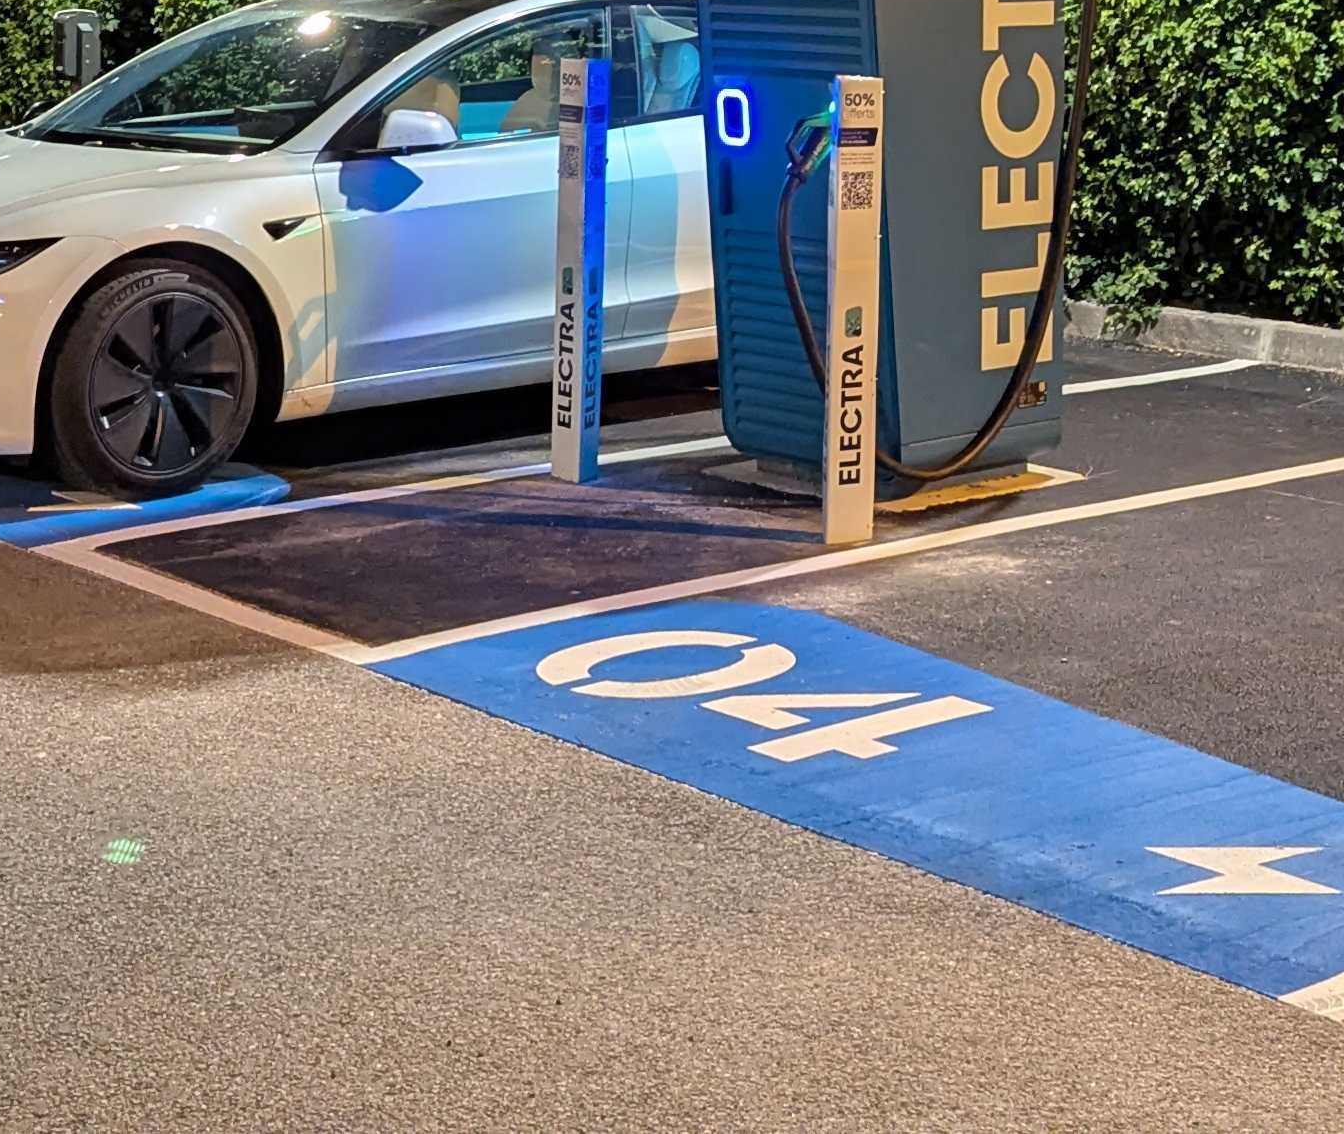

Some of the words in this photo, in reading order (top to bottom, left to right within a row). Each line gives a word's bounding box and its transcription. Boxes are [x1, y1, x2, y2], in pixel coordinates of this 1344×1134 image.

[561, 73, 582, 86] 50%
[844, 93, 876, 107] 50%
[557, 302, 575, 429] ELECTRA
[584, 301, 599, 430] ELECTRA
[838, 344, 864, 486] ELECTRA
[536, 629, 994, 760] 04
